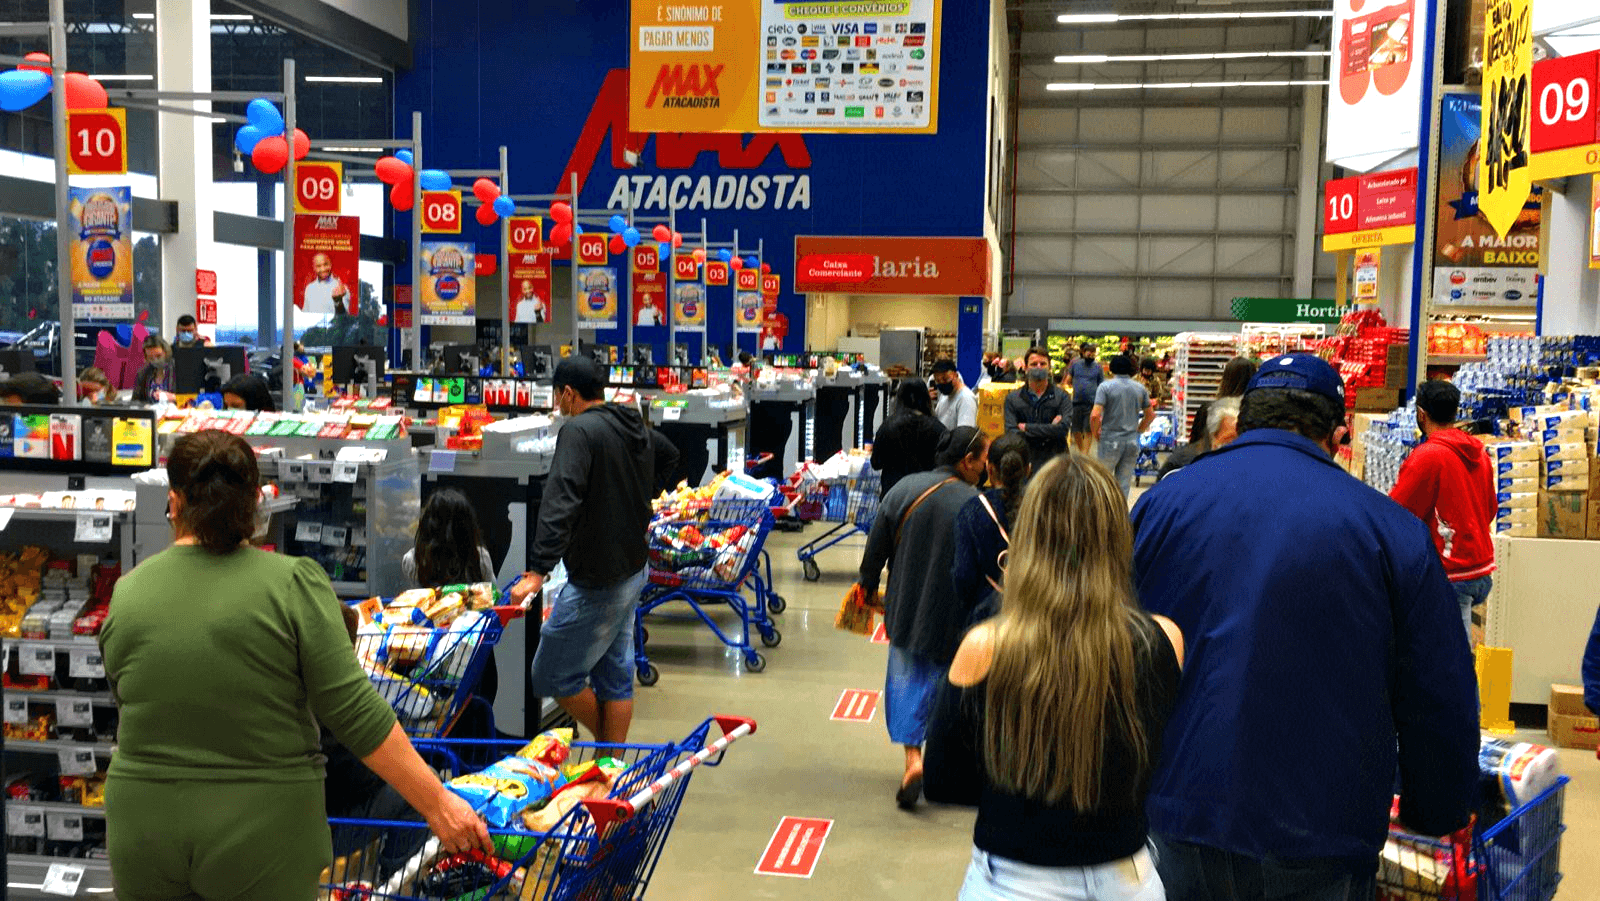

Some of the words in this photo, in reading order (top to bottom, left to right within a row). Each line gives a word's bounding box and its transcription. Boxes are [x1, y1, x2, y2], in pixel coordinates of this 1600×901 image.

[657, 4, 663, 22] É
[665, 5, 709, 22] SINÔNIMO
[711, 6, 723, 22] DE
[768, 23, 794, 35] cielo
[832, 22, 859, 35] VISA
[643, 30, 673, 47] PAGAR
[676, 29, 710, 47] MENOS
[645, 63, 724, 109] MAX
[663, 96, 720, 109] ATACADISTA
[1539, 77, 1590, 125] 09
[77, 128, 116, 157] 10
[302, 176, 335, 200] 09
[607, 174, 811, 210] ATACADISTA
[428, 203, 456, 222] 08
[1329, 193, 1353, 221] 10
[514, 227, 537, 244] 07
[1351, 233, 1384, 245] OFERTA
[1461, 236, 1475, 248] A
[1479, 235, 1538, 249] MAIOR
[581, 242, 603, 257] 06
[637, 252, 655, 266] 05
[823, 260, 848, 269] Caixa
[1484, 251, 1540, 264] BAIXO
[678, 261, 694, 274] 04
[709, 268, 724, 279] 03
[808, 268, 863, 278] Comerciante
[740, 275, 755, 286] 02
[764, 279, 776, 289] 01
